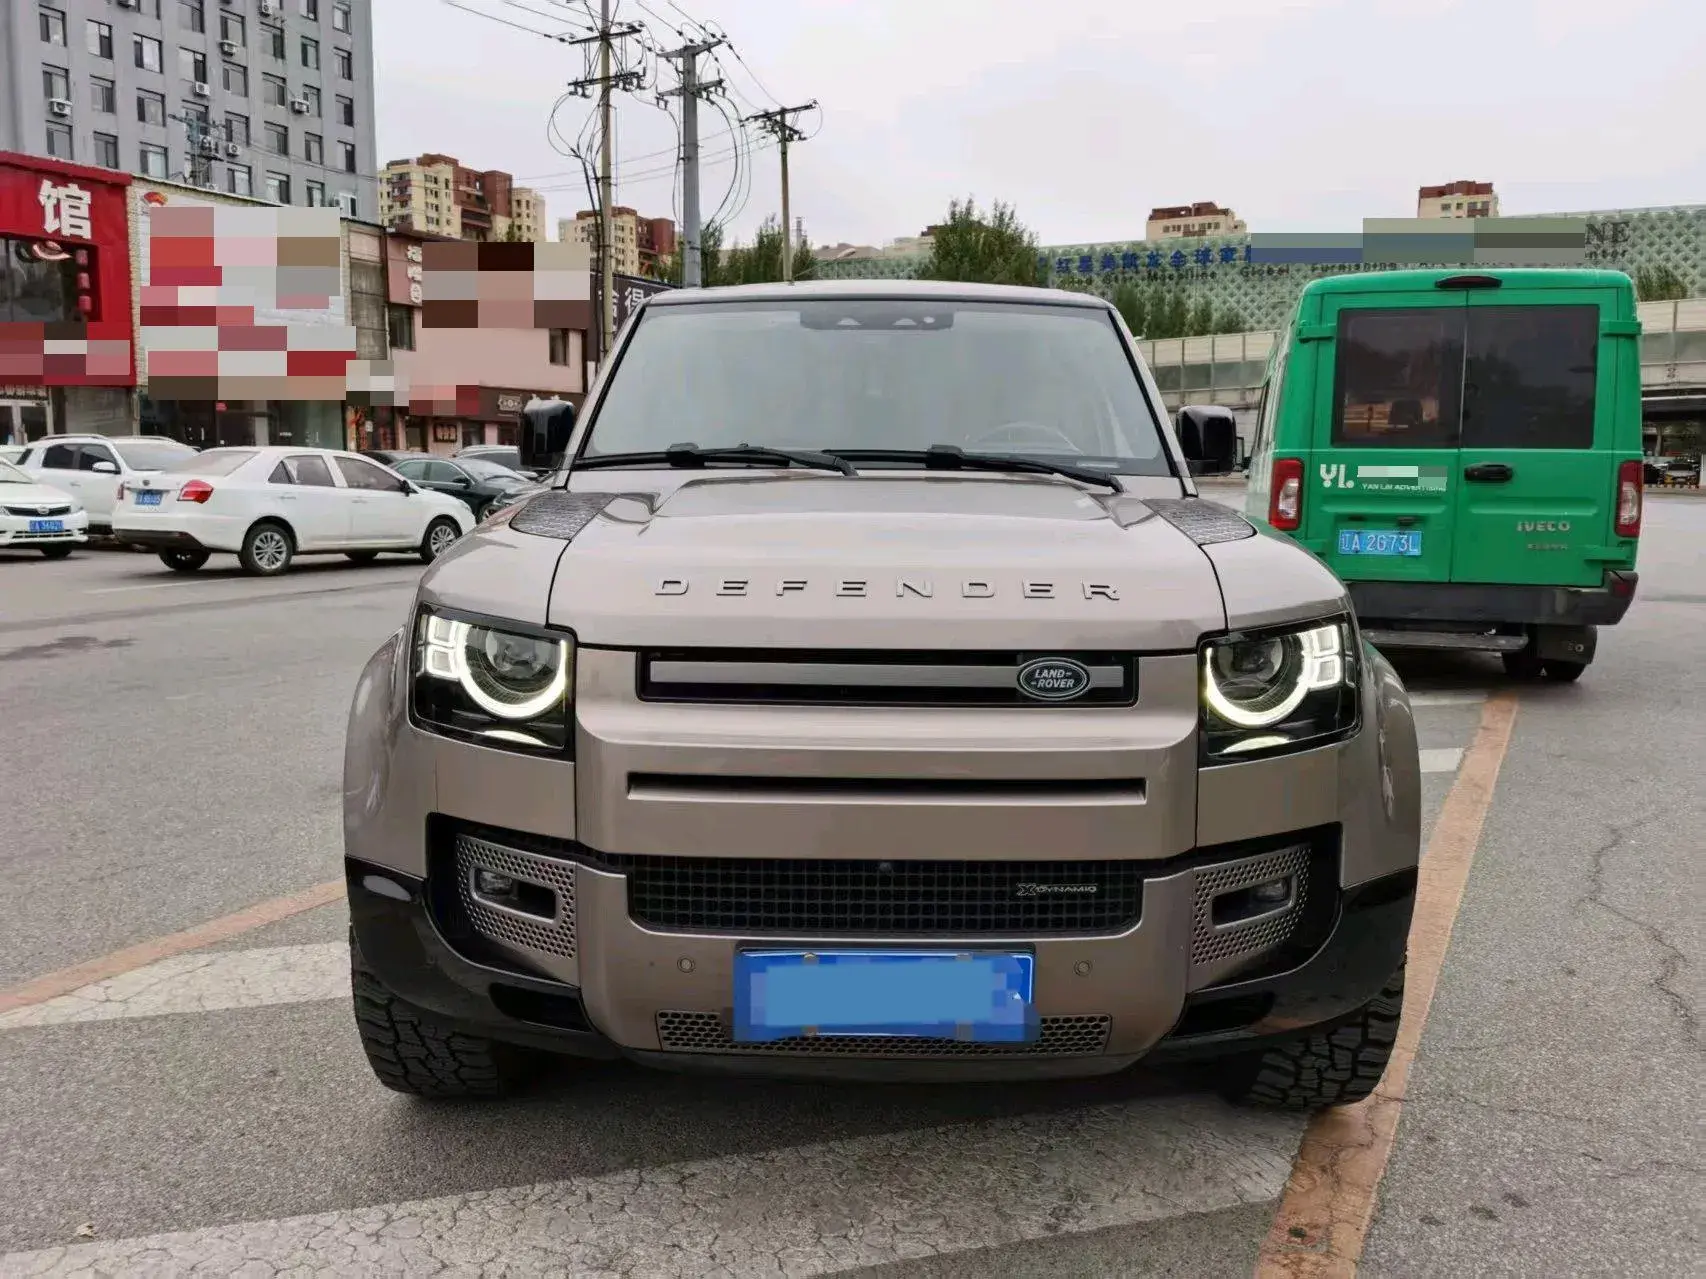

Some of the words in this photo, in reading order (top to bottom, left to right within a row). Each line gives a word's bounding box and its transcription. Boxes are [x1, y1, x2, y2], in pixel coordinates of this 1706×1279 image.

[38, 179, 92, 239] 馆
[1517, 520, 1570, 531] IVECO
[655, 576, 1120, 600] DEFENDER
